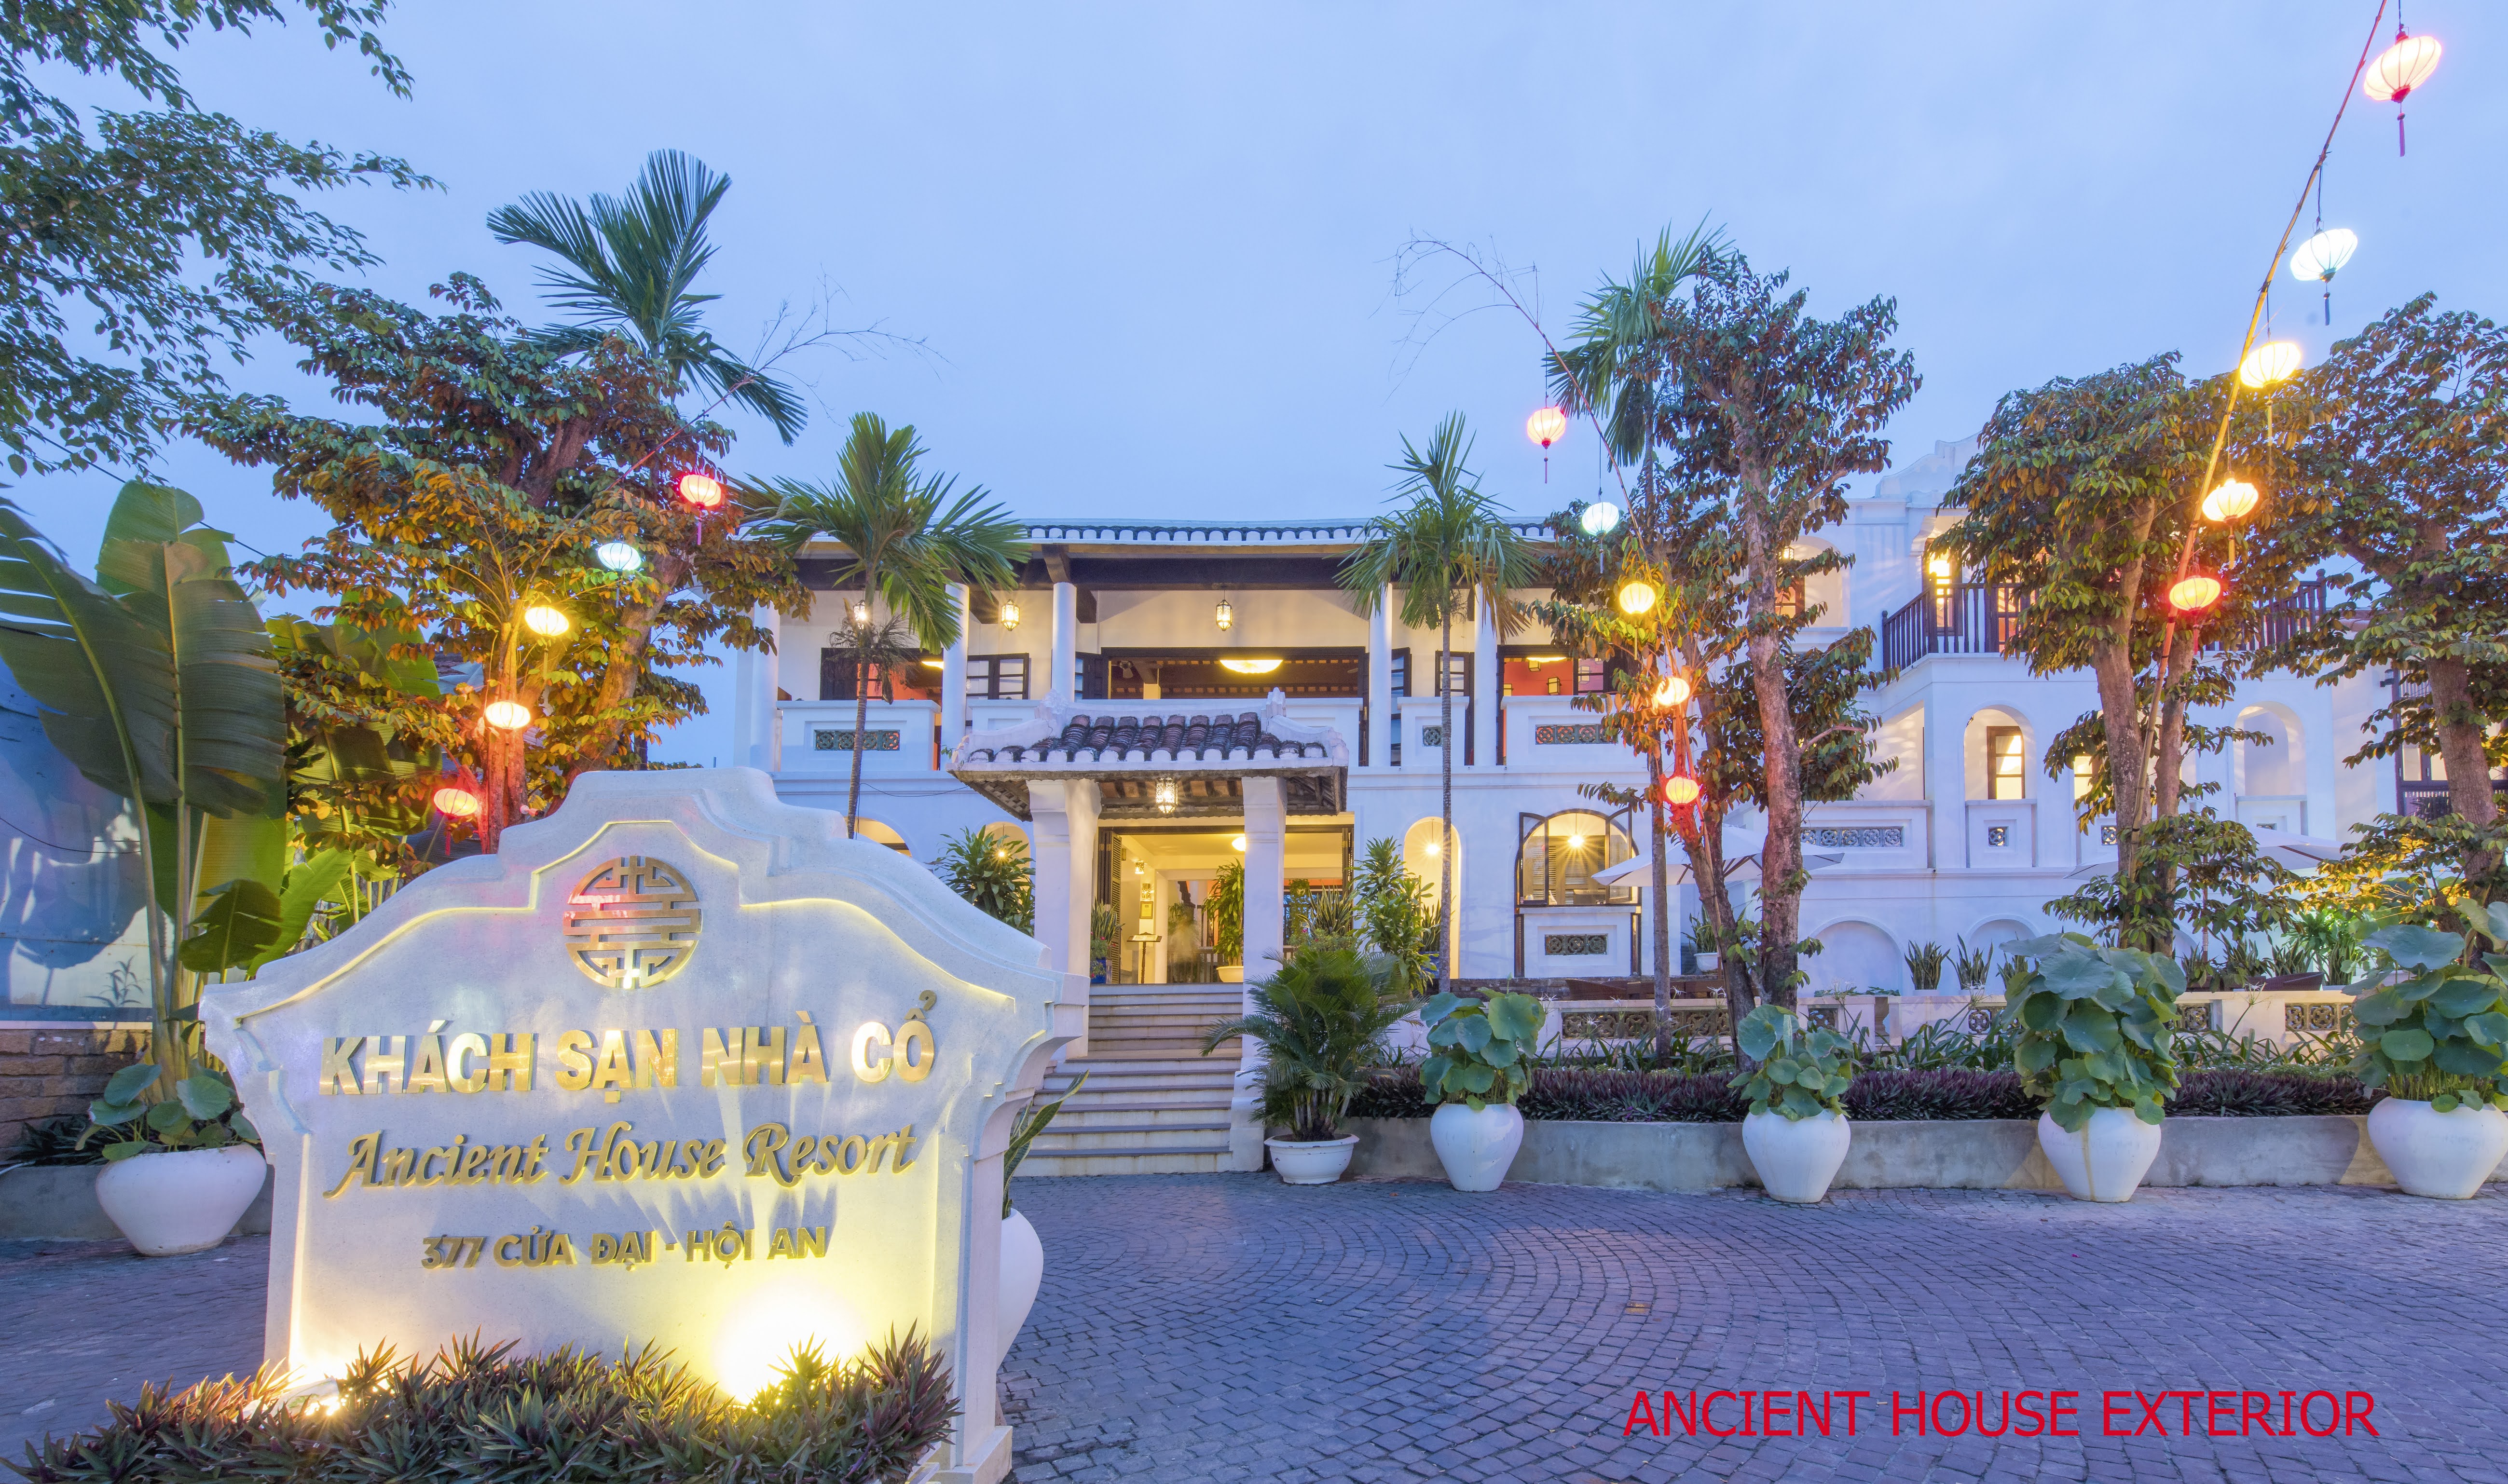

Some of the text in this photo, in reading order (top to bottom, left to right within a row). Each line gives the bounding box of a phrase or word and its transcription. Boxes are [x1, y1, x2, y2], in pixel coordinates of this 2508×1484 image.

[319, 990, 937, 1103] KHÁCH SẠN NHÀ CỔ
[323, 1121, 916, 1198] Ancient House Resort
[421, 1236, 483, 1269] 377
[493, 1225, 575, 1266] CỬA
[590, 1232, 655, 1271] ĐẠI
[686, 1222, 754, 1268] HỘI
[767, 1227, 826, 1259] AN
